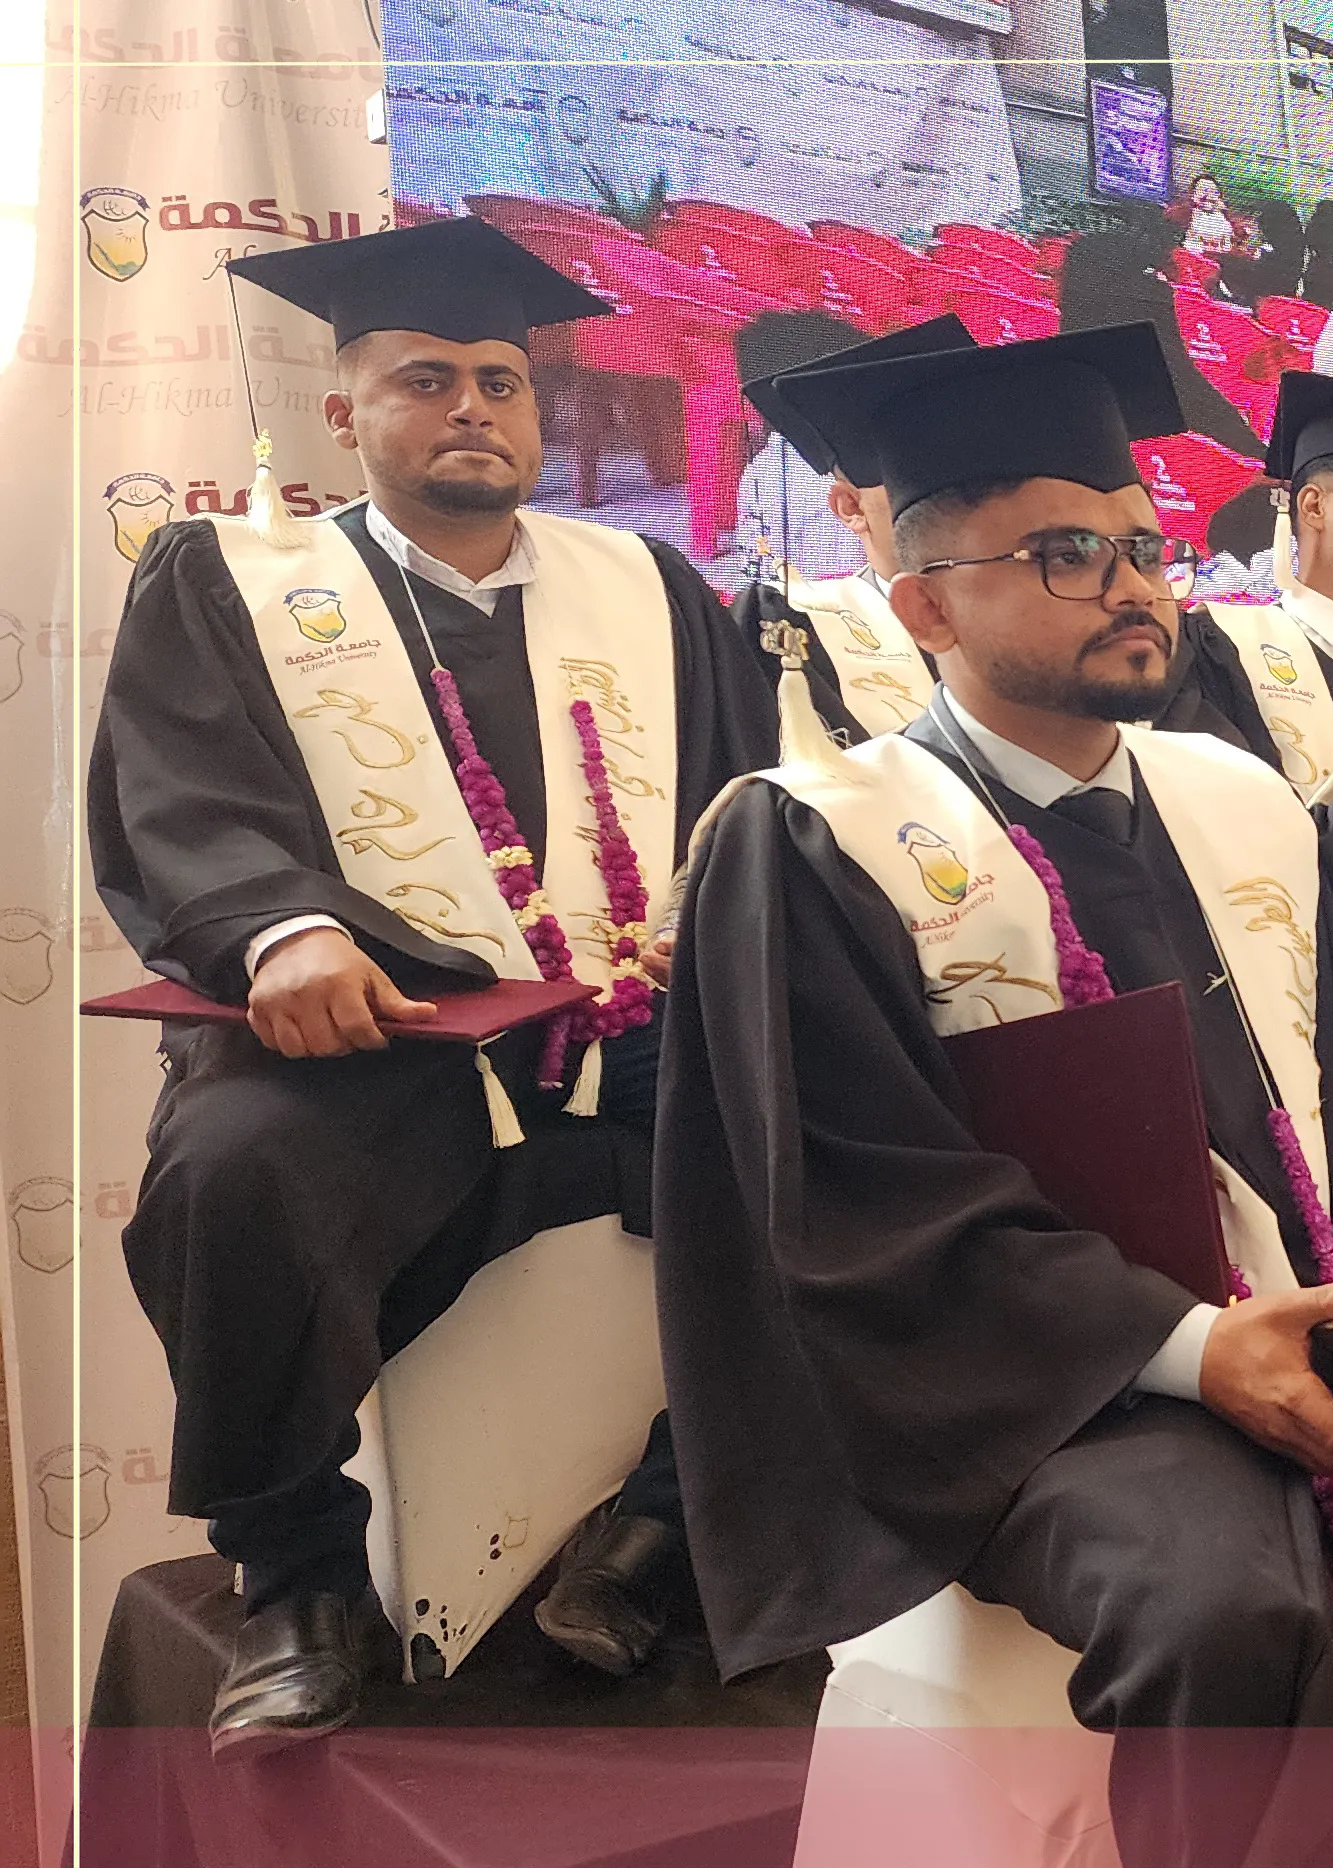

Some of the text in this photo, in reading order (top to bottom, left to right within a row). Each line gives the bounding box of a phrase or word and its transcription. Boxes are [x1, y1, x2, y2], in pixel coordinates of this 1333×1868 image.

[215, 77, 366, 131] Universit
[159, 194, 361, 244] الحكمة
[285, 639, 382, 666] جامعة الحكمة
